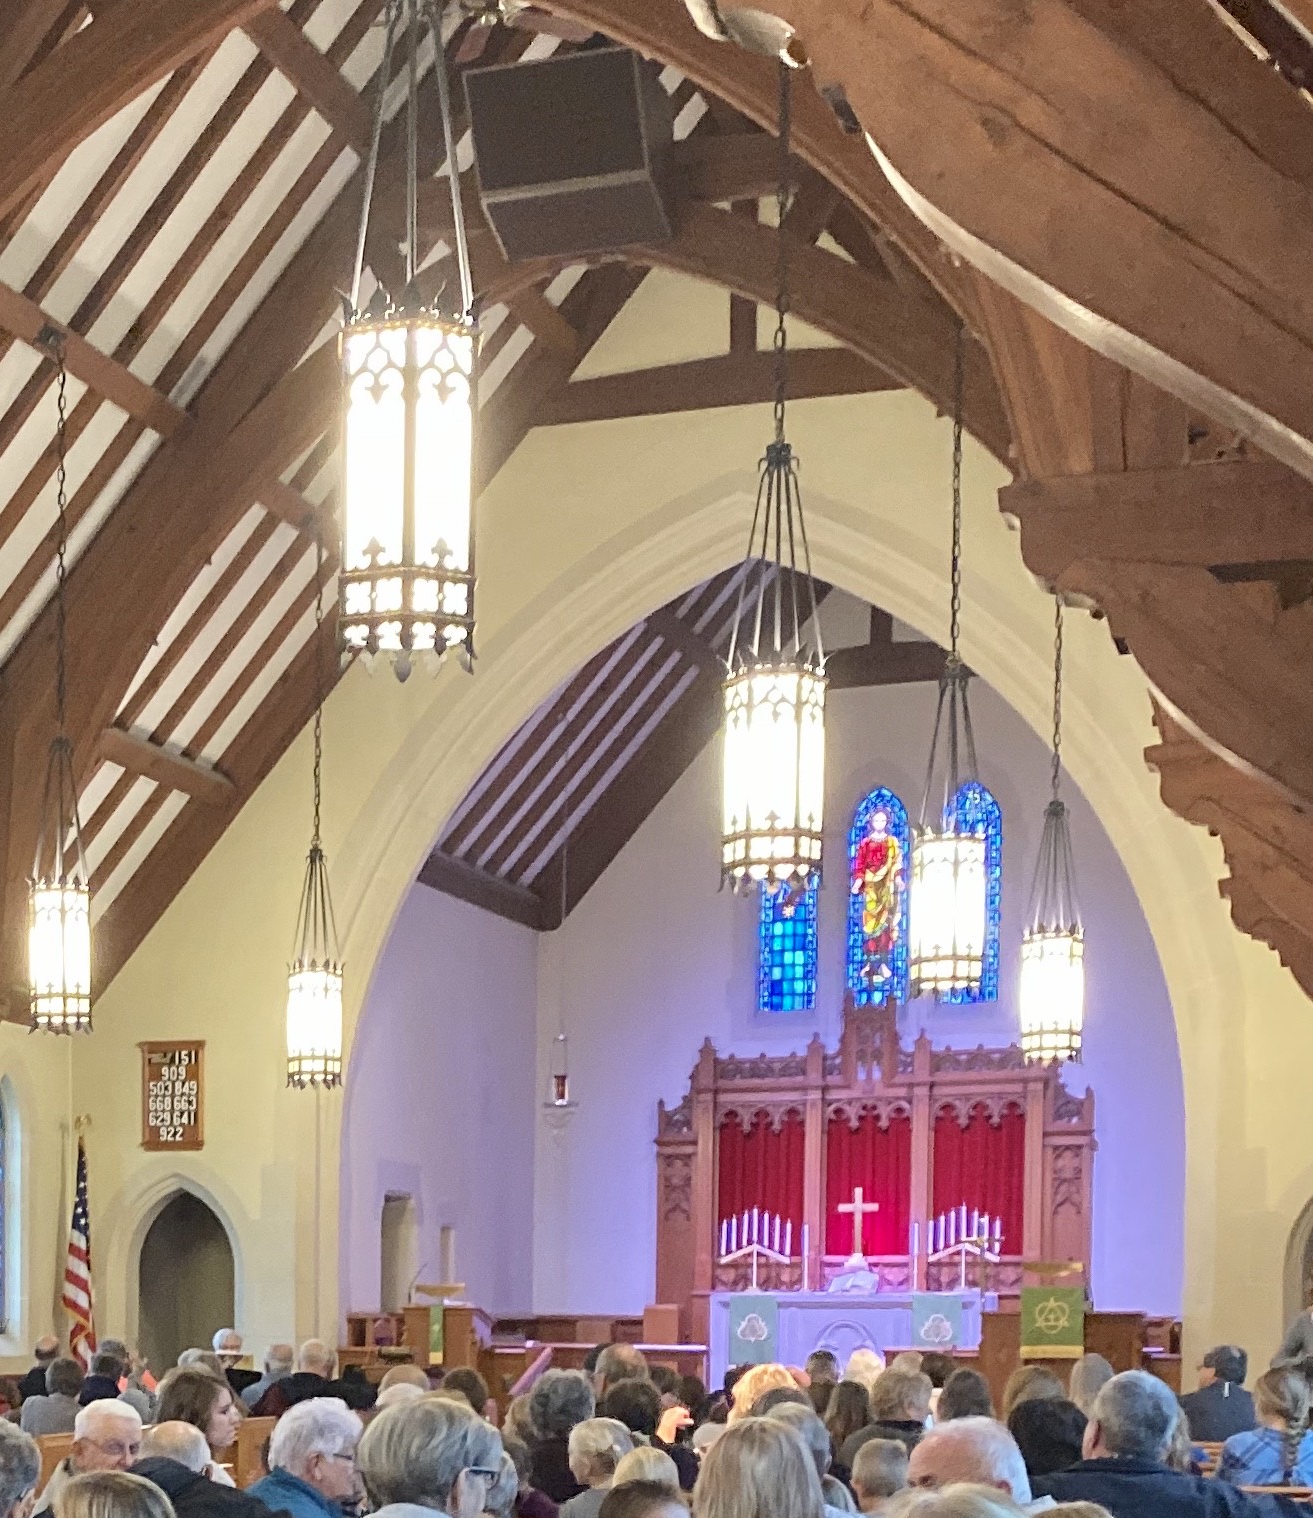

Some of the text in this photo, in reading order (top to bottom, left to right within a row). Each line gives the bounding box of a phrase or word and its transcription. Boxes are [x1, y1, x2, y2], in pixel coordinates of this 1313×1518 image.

[175, 1050, 196, 1065] 151
[161, 1066, 186, 1080] 909
[149, 1080, 197, 1096] 503 849
[173, 1095, 197, 1111] 663
[149, 1111, 195, 1126] 629 641
[159, 1126, 184, 1141] 922
